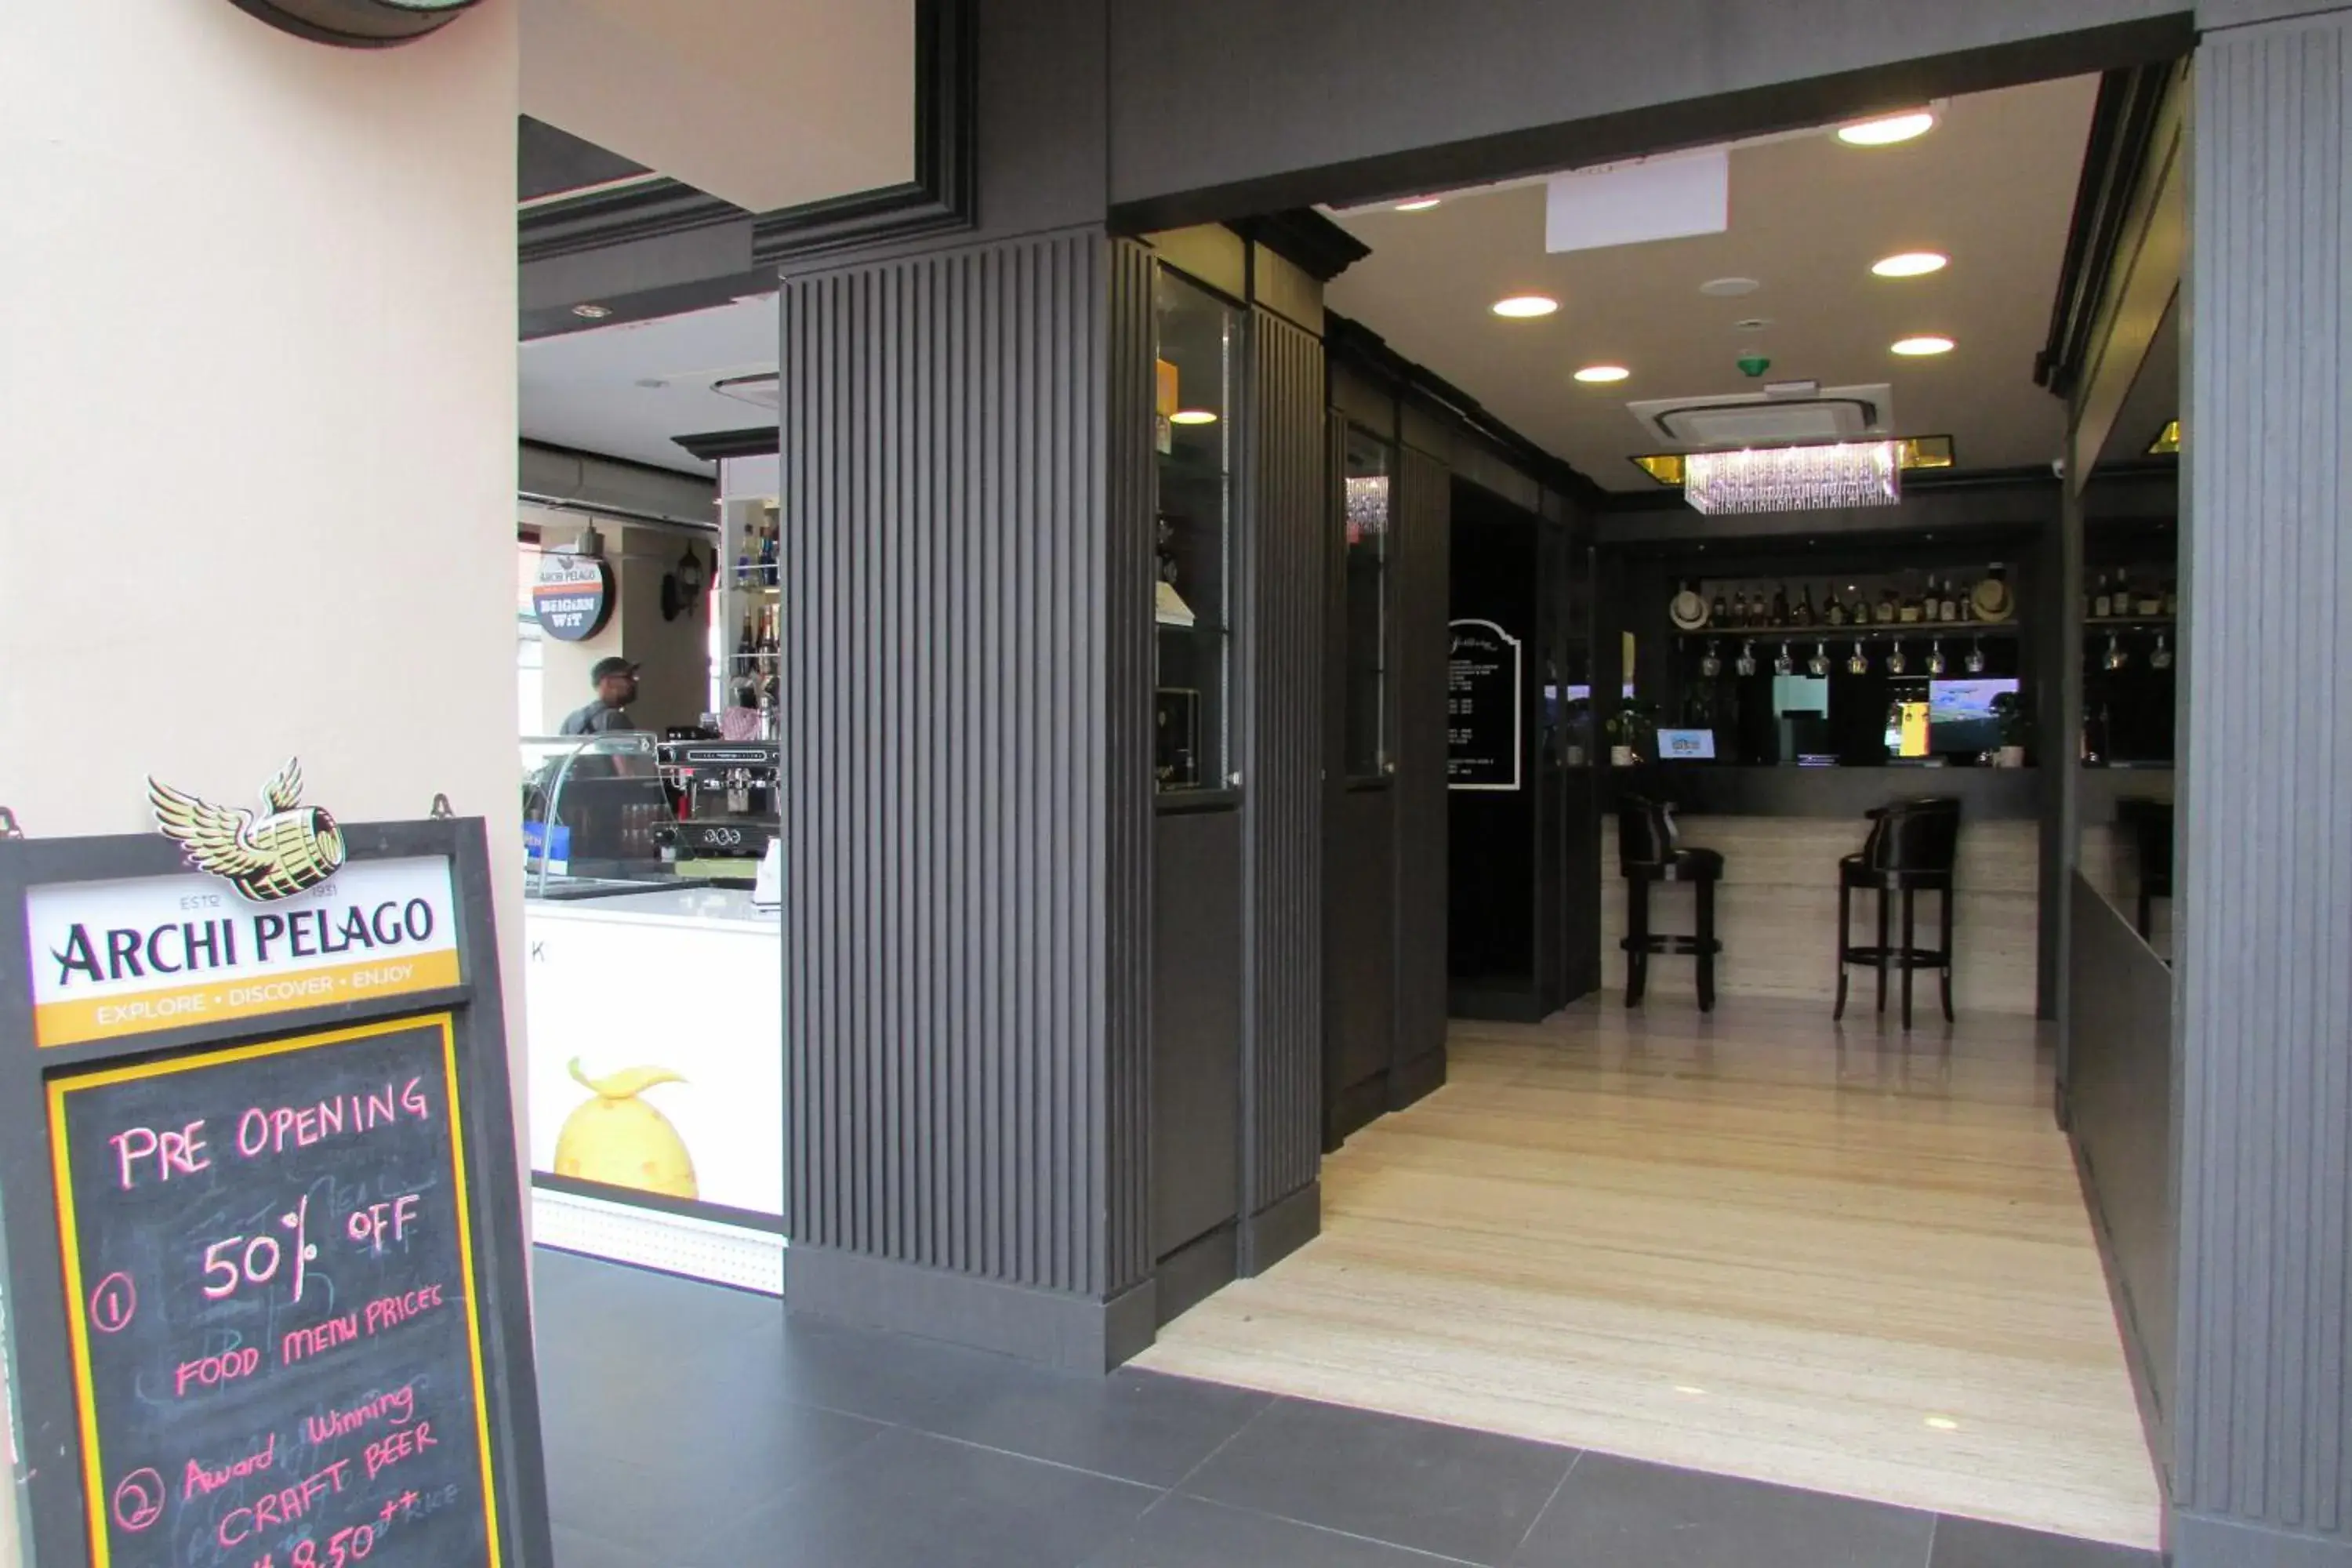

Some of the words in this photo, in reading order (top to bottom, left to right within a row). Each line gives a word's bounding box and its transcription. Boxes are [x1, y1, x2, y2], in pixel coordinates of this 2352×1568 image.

[50, 918, 237, 985] ARCHI
[252, 897, 434, 962] PELAGO
[97, 993, 207, 1026] EXPLORE
[228, 975, 334, 1007] DISCOVER
[351, 963, 414, 989] ENJOY
[110, 1120, 210, 1190] PRE
[238, 1077, 429, 1158] OPENING
[201, 1192, 318, 1303] 50%
[348, 1193, 421, 1251] OFF
[175, 1346, 260, 1397] FOOD
[283, 1313, 358, 1367] MENU
[183, 1432, 276, 1501] Award
[307, 1383, 414, 1446] Winning
[217, 1458, 350, 1548] CRAFT
[363, 1421, 438, 1481] BEER
